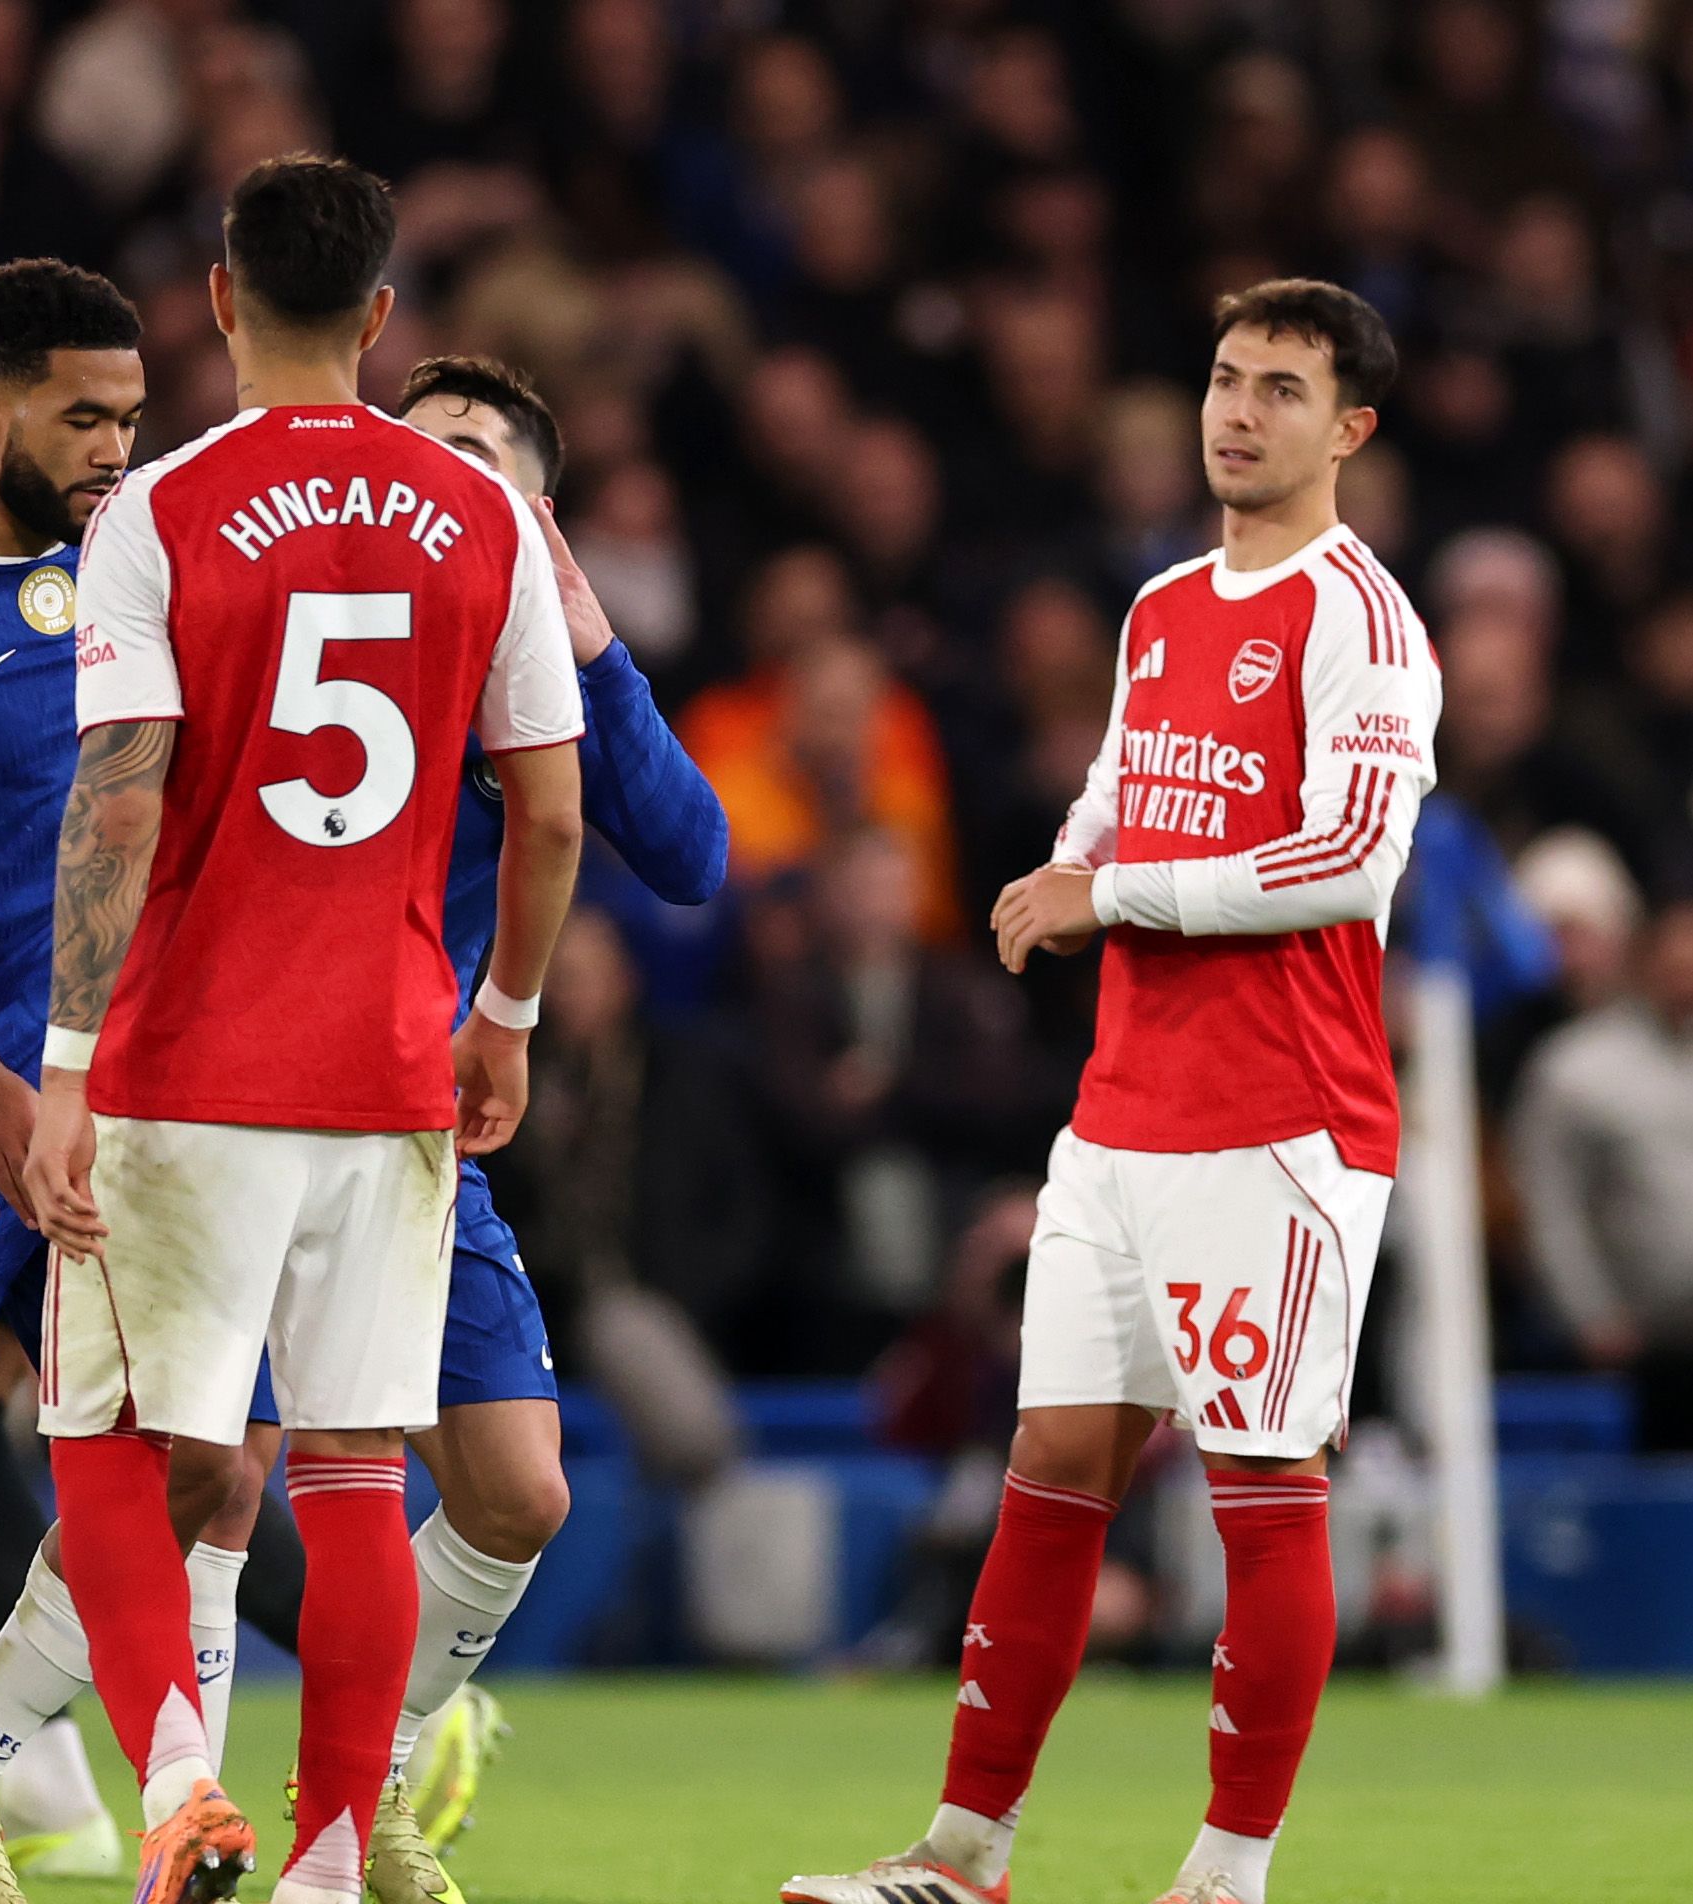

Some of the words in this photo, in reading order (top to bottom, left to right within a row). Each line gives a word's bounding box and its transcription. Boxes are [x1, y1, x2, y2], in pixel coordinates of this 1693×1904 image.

[288, 415, 355, 430] Arsenal
[218, 476, 463, 562] HINCAPIE
[24, 581, 36, 616] WORLD
[35, 572, 74, 602] CHAMPIONS
[44, 615, 68, 630] FIFA
[75, 624, 95, 650] SIT
[76, 641, 116, 673] NDA
[257, 592, 416, 848] 5
[1355, 712, 1410, 735] VISIT
[1331, 734, 1422, 764] RWANDA
[1140, 784, 1227, 840] BETTER
[1166, 1282, 1269, 1381] 36
